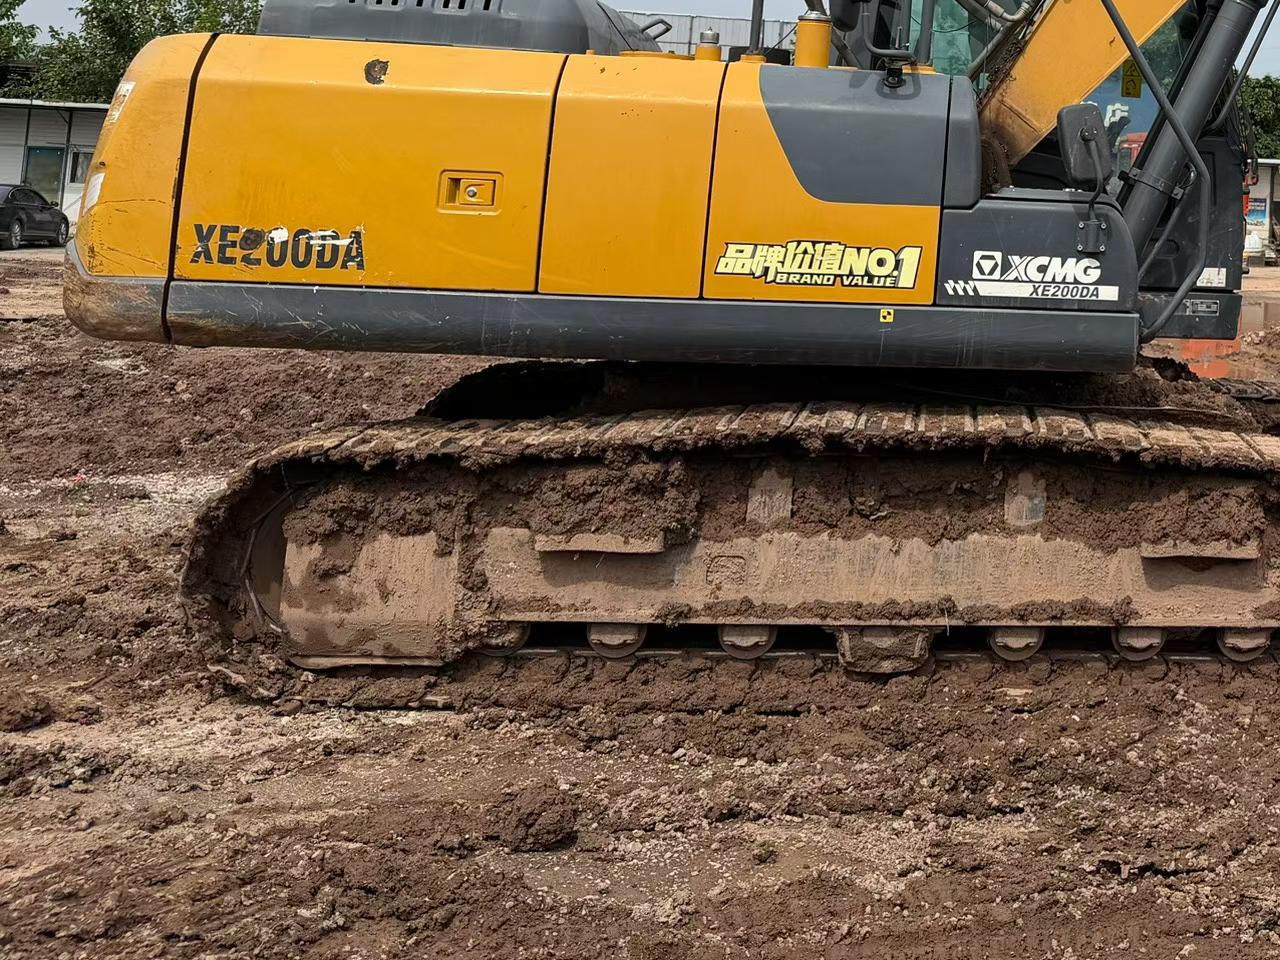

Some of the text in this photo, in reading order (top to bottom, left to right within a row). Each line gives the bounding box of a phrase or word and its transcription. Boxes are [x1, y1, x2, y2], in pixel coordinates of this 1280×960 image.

[1000, 255, 1101, 284] XCMG
[775, 272, 897, 287] BRAND VALUE
[1029, 284, 1100, 299] XE200DA
